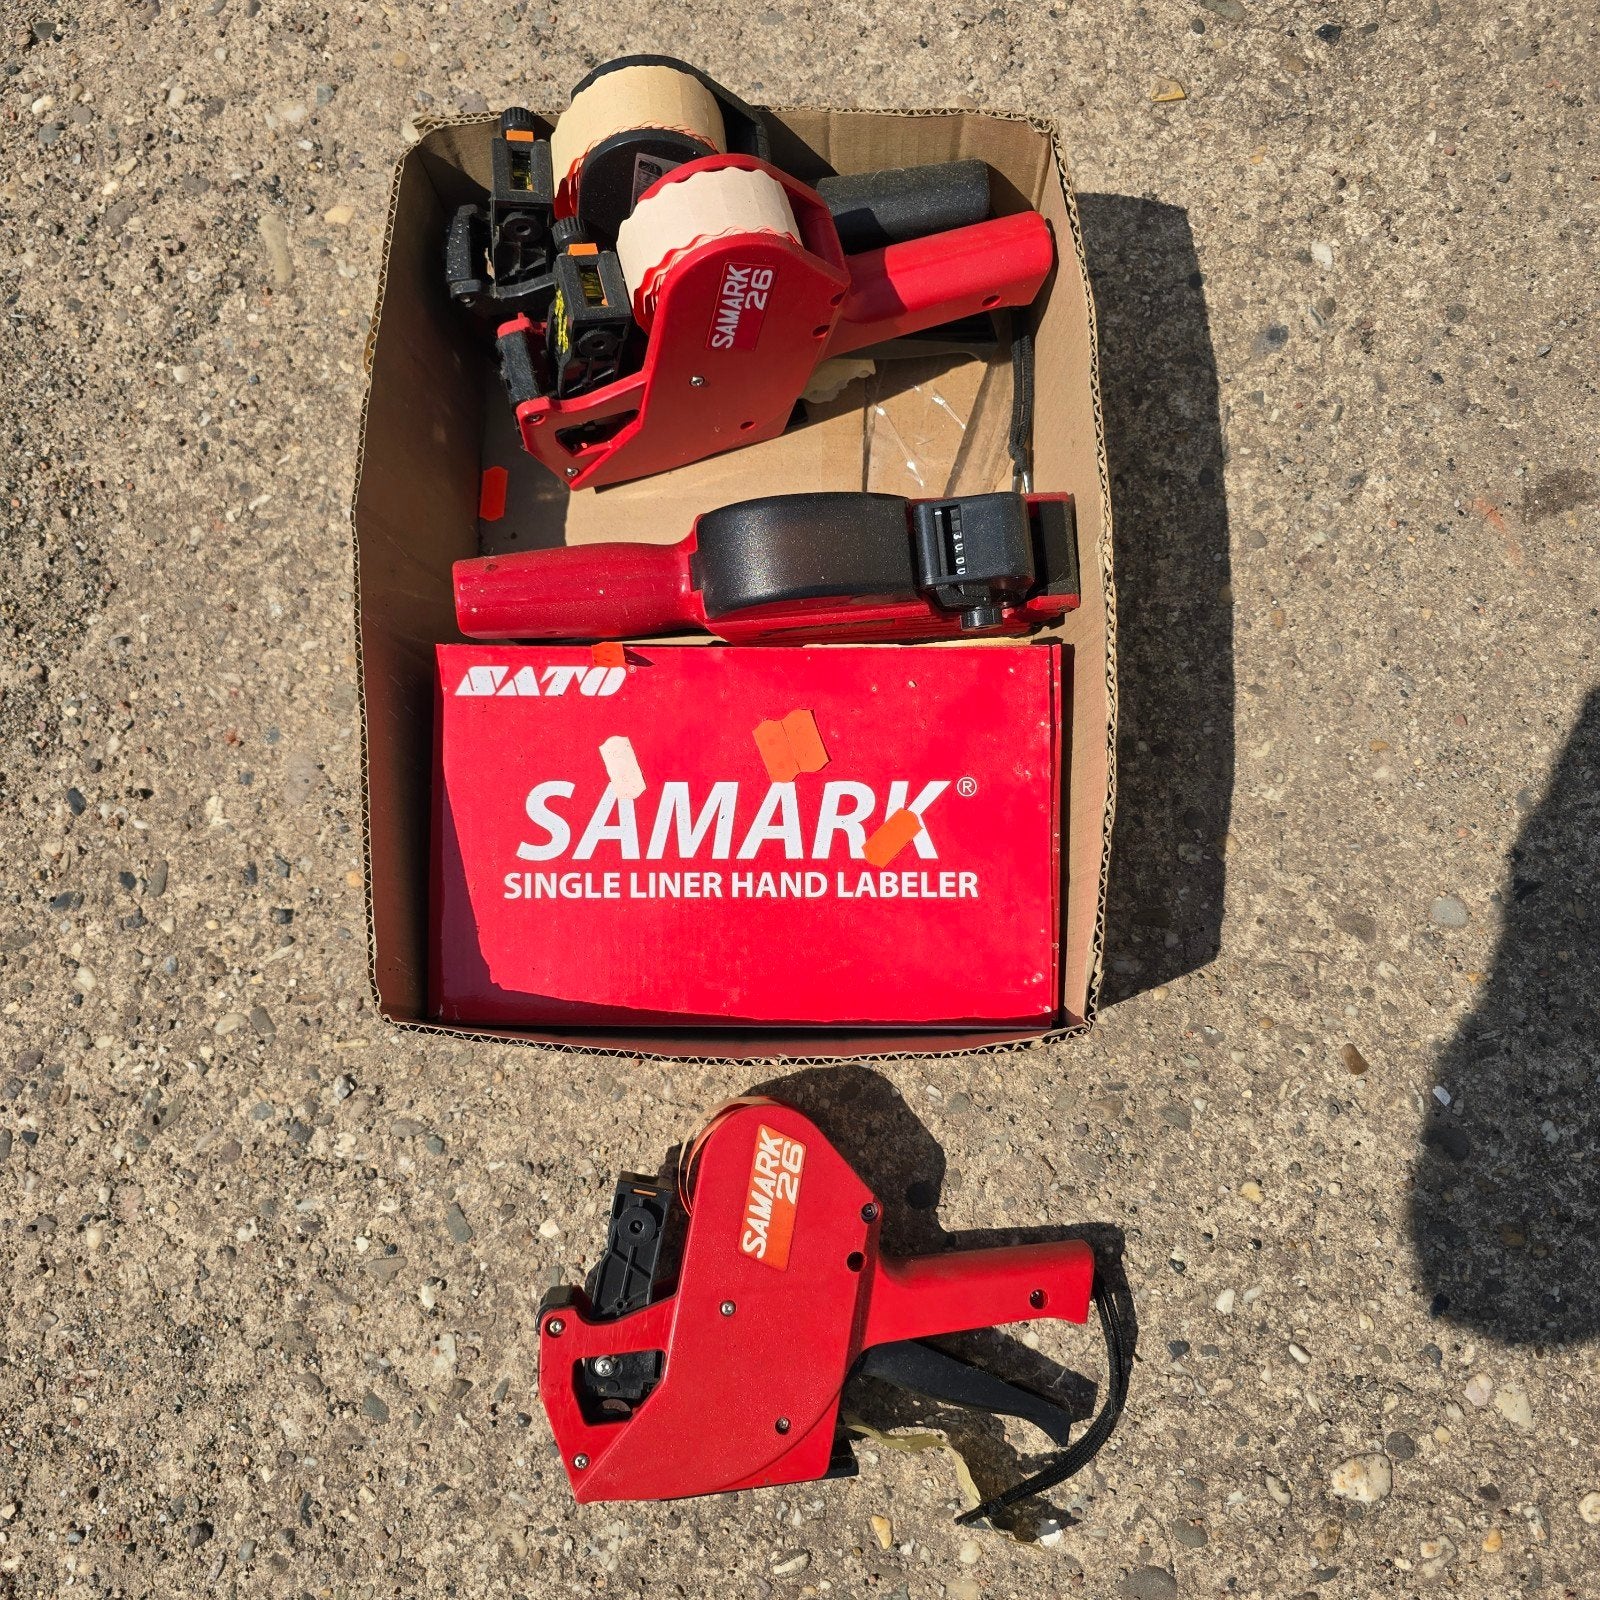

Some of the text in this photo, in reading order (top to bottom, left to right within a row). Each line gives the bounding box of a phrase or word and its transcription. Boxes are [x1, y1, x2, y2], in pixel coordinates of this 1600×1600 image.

[711, 264, 752, 350] SAMARK
[744, 269, 773, 310] 26
[503, 871, 980, 900] SINGLE LINER HAND LABELER
[742, 1127, 784, 1259] SAMARK
[776, 1140, 804, 1205] 26
